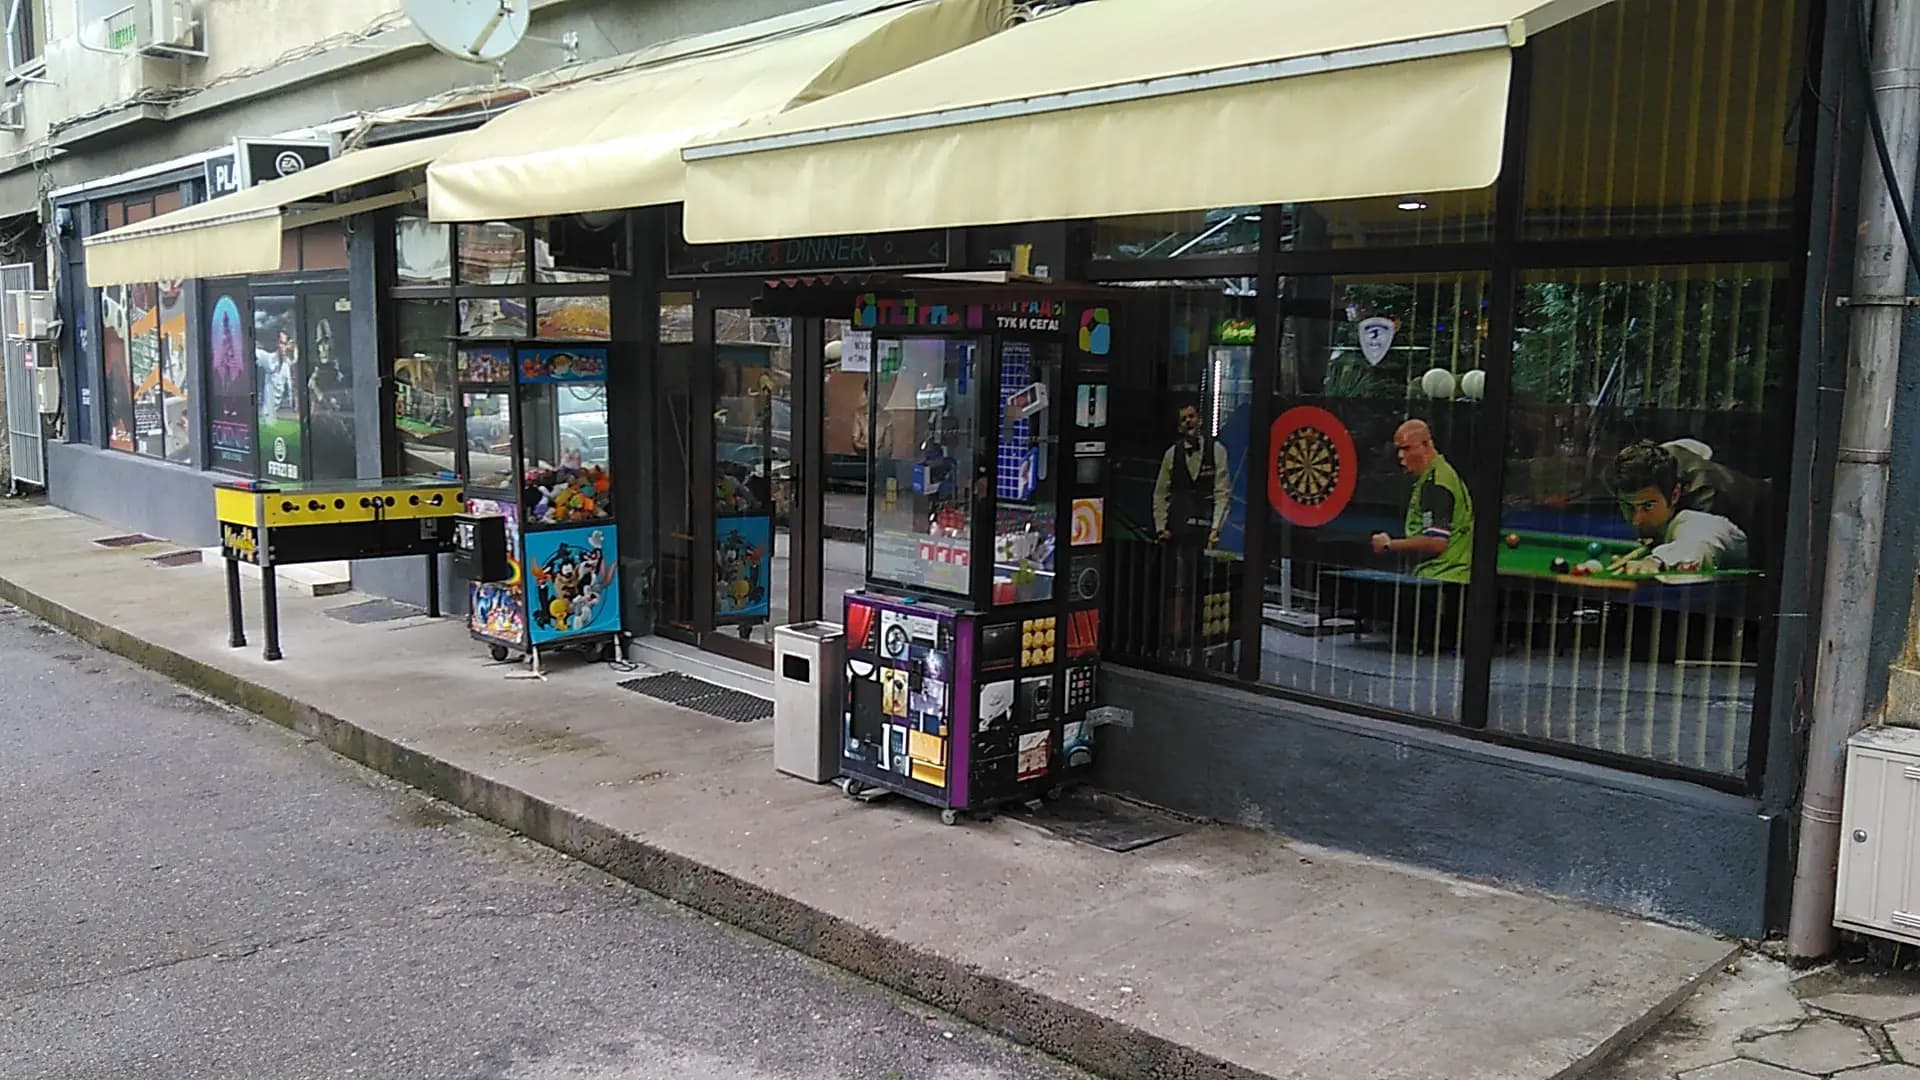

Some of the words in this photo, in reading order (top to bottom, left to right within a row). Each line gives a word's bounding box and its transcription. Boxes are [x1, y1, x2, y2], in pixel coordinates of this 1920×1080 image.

[725, 243, 765, 267] BAR
[786, 236, 867, 263] DINNER
[996, 317, 1017, 329] ТУК
[1018, 318, 1028, 329] И
[1029, 318, 1060, 331] СЕГА!
